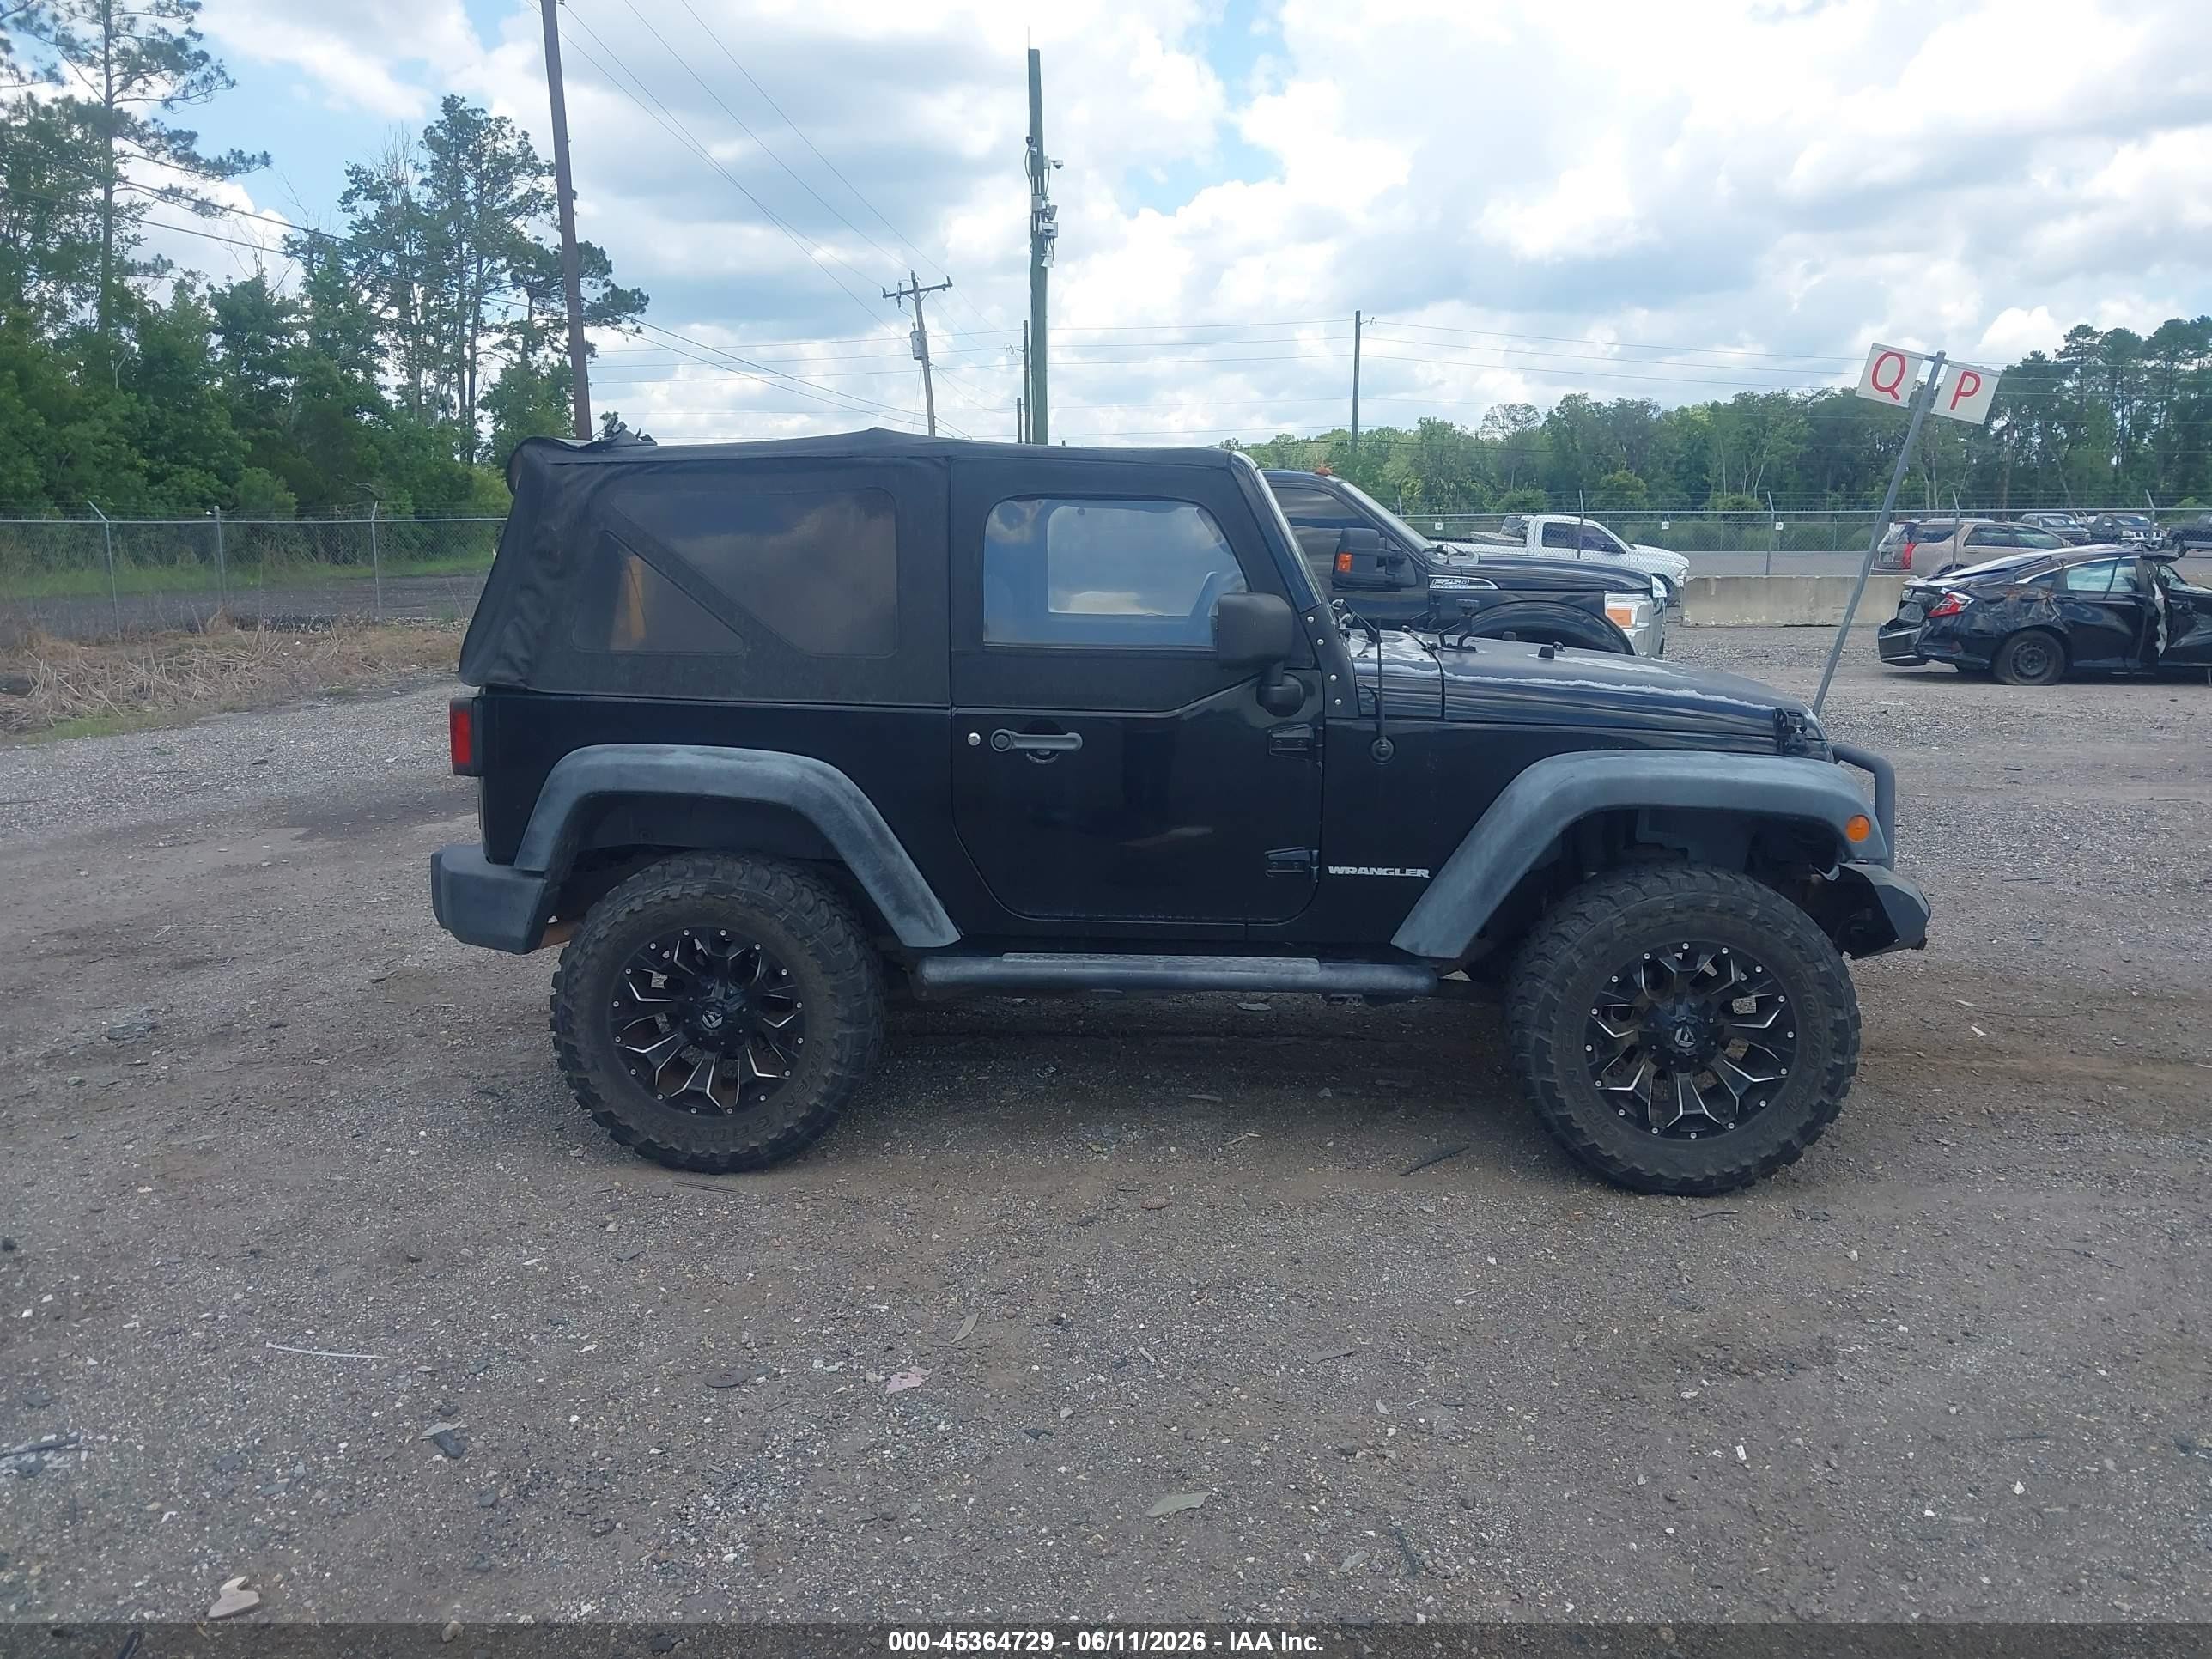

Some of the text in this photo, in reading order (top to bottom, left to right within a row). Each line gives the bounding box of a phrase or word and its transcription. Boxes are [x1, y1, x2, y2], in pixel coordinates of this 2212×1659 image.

[1871, 350, 1906, 401] Q
[1949, 370, 1982, 410] P
[1328, 866, 1431, 878] WRANGLER
